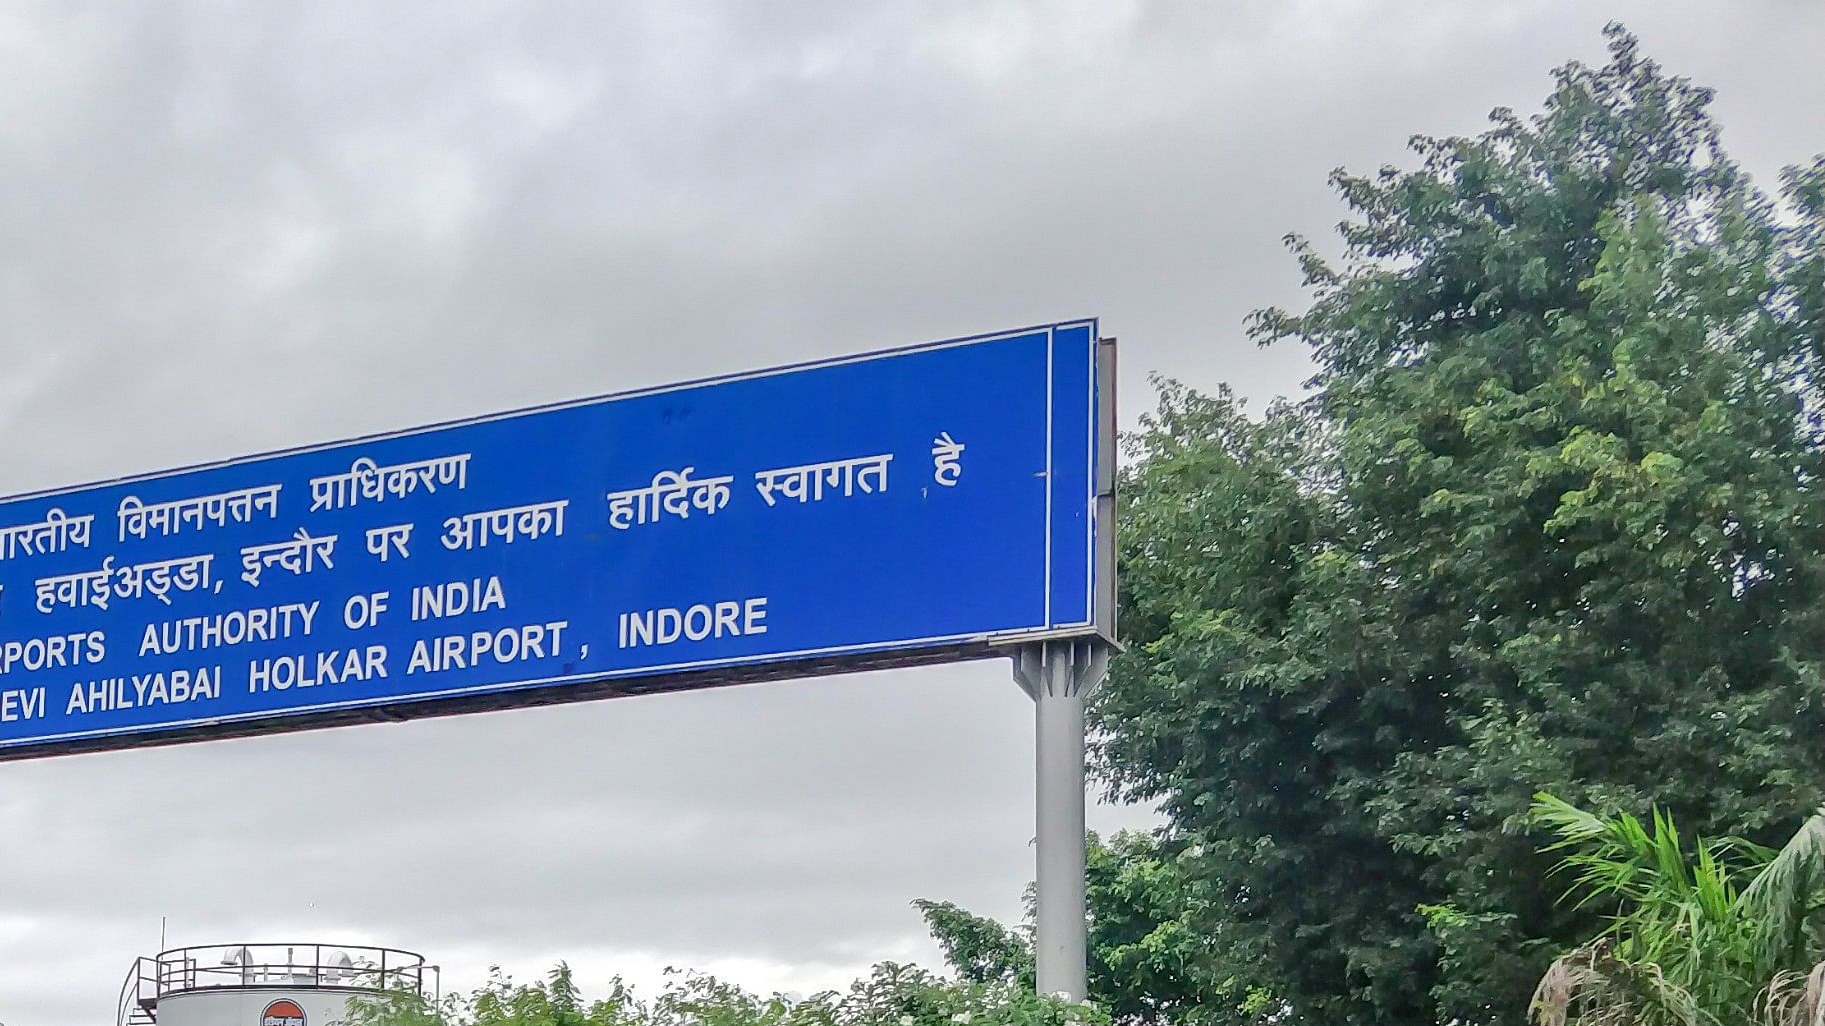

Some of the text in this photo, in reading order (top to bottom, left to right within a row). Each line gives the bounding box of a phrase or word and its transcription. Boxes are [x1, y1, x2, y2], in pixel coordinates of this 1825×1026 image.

[118, 483, 282, 543] विमानपत्तन
[309, 452, 473, 513] प्राधिकरण
[241, 527, 338, 588] इन्दौर
[366, 522, 414, 563] पर
[440, 498, 569, 552] आपका
[607, 466, 735, 532] हार्दिक
[755, 453, 894, 508] स्वागत
[931, 431, 966, 489] है
[66, 665, 222, 716] AHILYABAI
[249, 645, 389, 694] HOLKAR
[618, 596, 769, 649] INDORE
[139, 601, 321, 657] AUTHORITY
[343, 591, 391, 631] OF
[411, 575, 507, 621] INDIA
